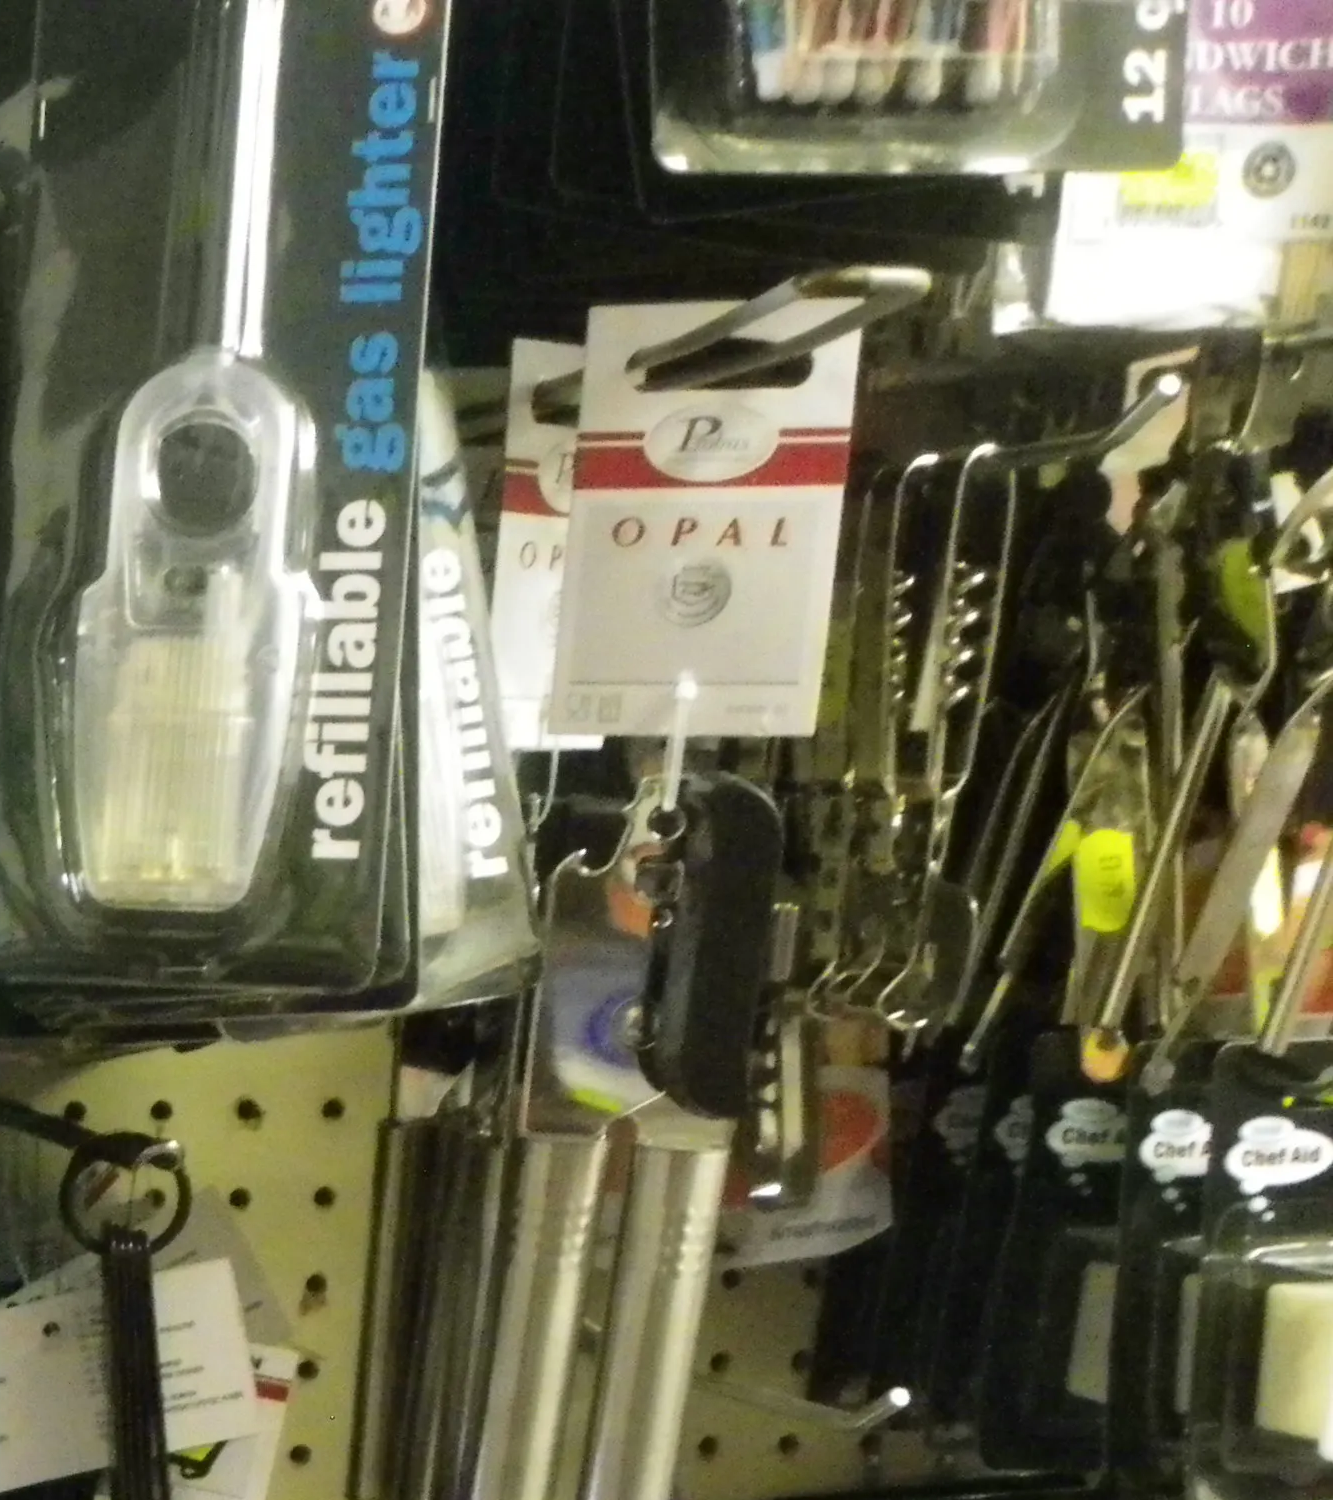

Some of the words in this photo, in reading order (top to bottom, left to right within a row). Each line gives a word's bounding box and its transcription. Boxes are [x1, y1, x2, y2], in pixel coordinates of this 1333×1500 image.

[1122, 48, 1167, 123] 12
[340, 51, 423, 302] lighter
[336, 330, 405, 473] gas
[611, 516, 789, 548] OPAL
[302, 499, 387, 860] refillable
